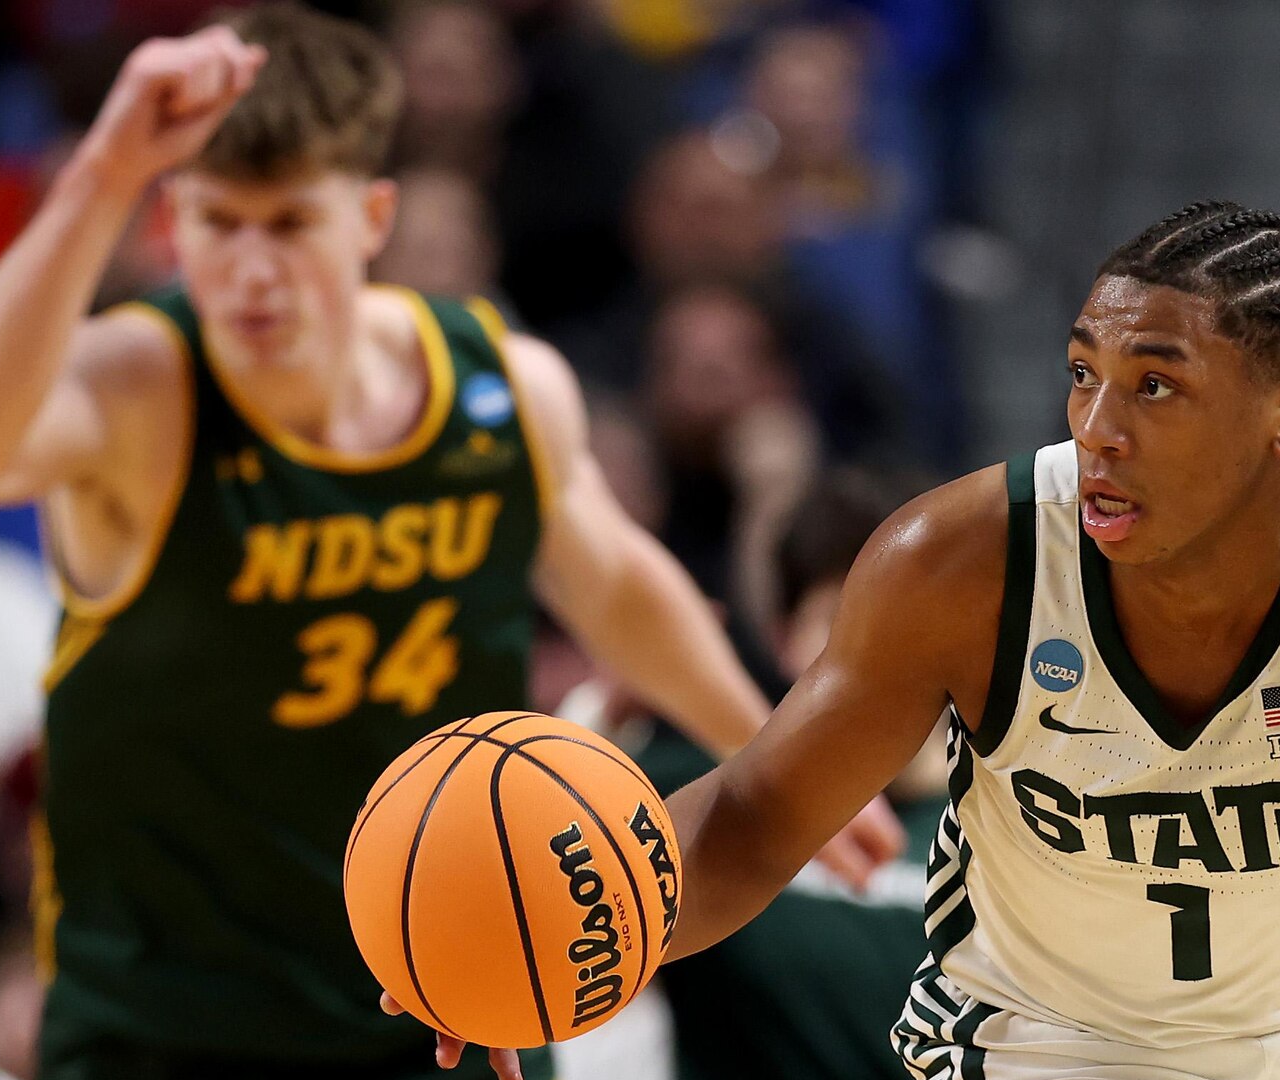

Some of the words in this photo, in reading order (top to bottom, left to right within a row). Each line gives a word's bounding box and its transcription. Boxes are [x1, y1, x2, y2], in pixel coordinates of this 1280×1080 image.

[229, 492, 502, 603] NDSU
[272, 597, 458, 729] 34
[1034, 660, 1079, 684] NCAA
[549, 820, 624, 1029] Wilson
[613, 891, 627, 921] NXT
[627, 801, 679, 953] NCAA
[1146, 883, 1213, 982] 1
